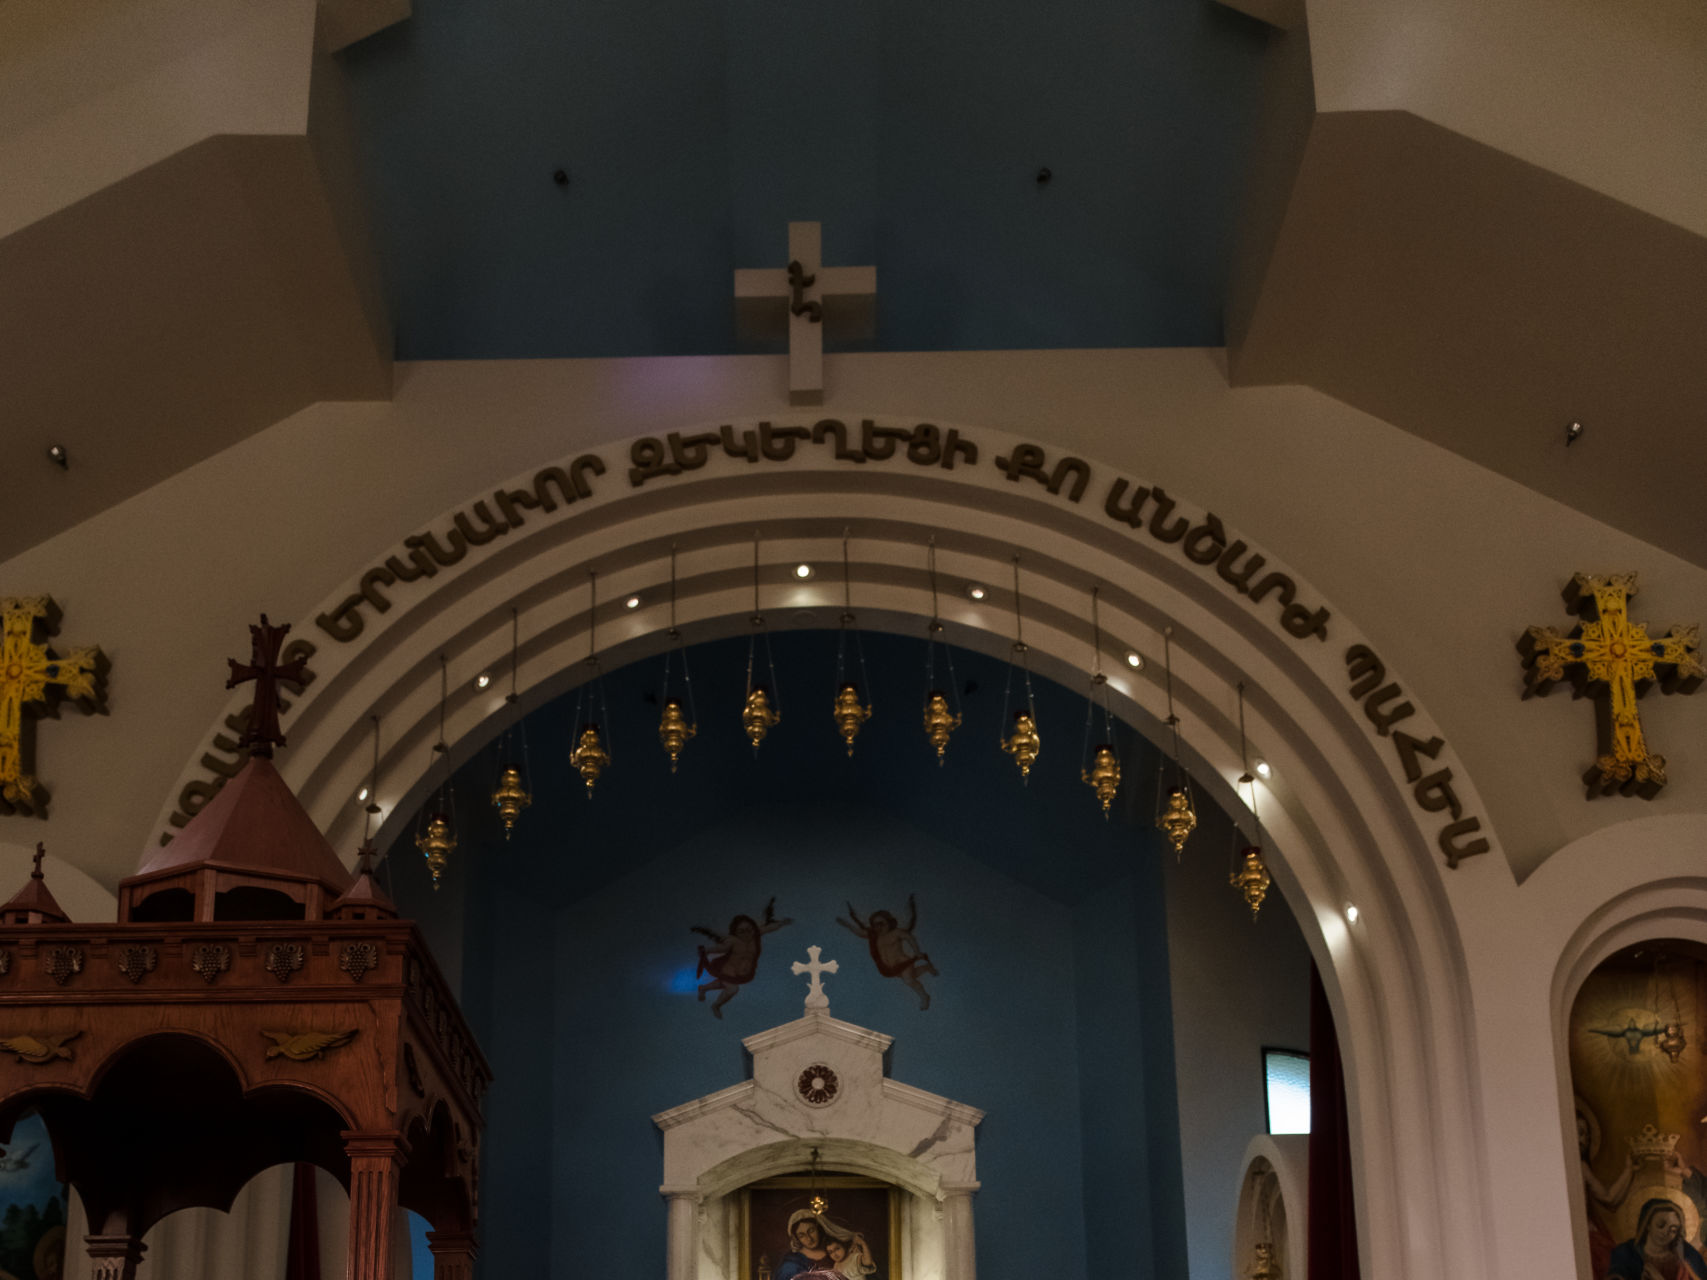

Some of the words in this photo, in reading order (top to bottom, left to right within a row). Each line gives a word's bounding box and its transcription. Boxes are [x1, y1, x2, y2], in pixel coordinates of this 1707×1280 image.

[315, 453, 606, 643] ԵՐԿՆԱՒՈՐ
[628, 419, 979, 488] ԶԵԿԵՂԵՑԻ
[995, 443, 1091, 504] ՔՈ
[1104, 477, 1331, 643] ԱՆՇԱՐԺ
[1345, 643, 1491, 870] ՊԱՀԵԱ
